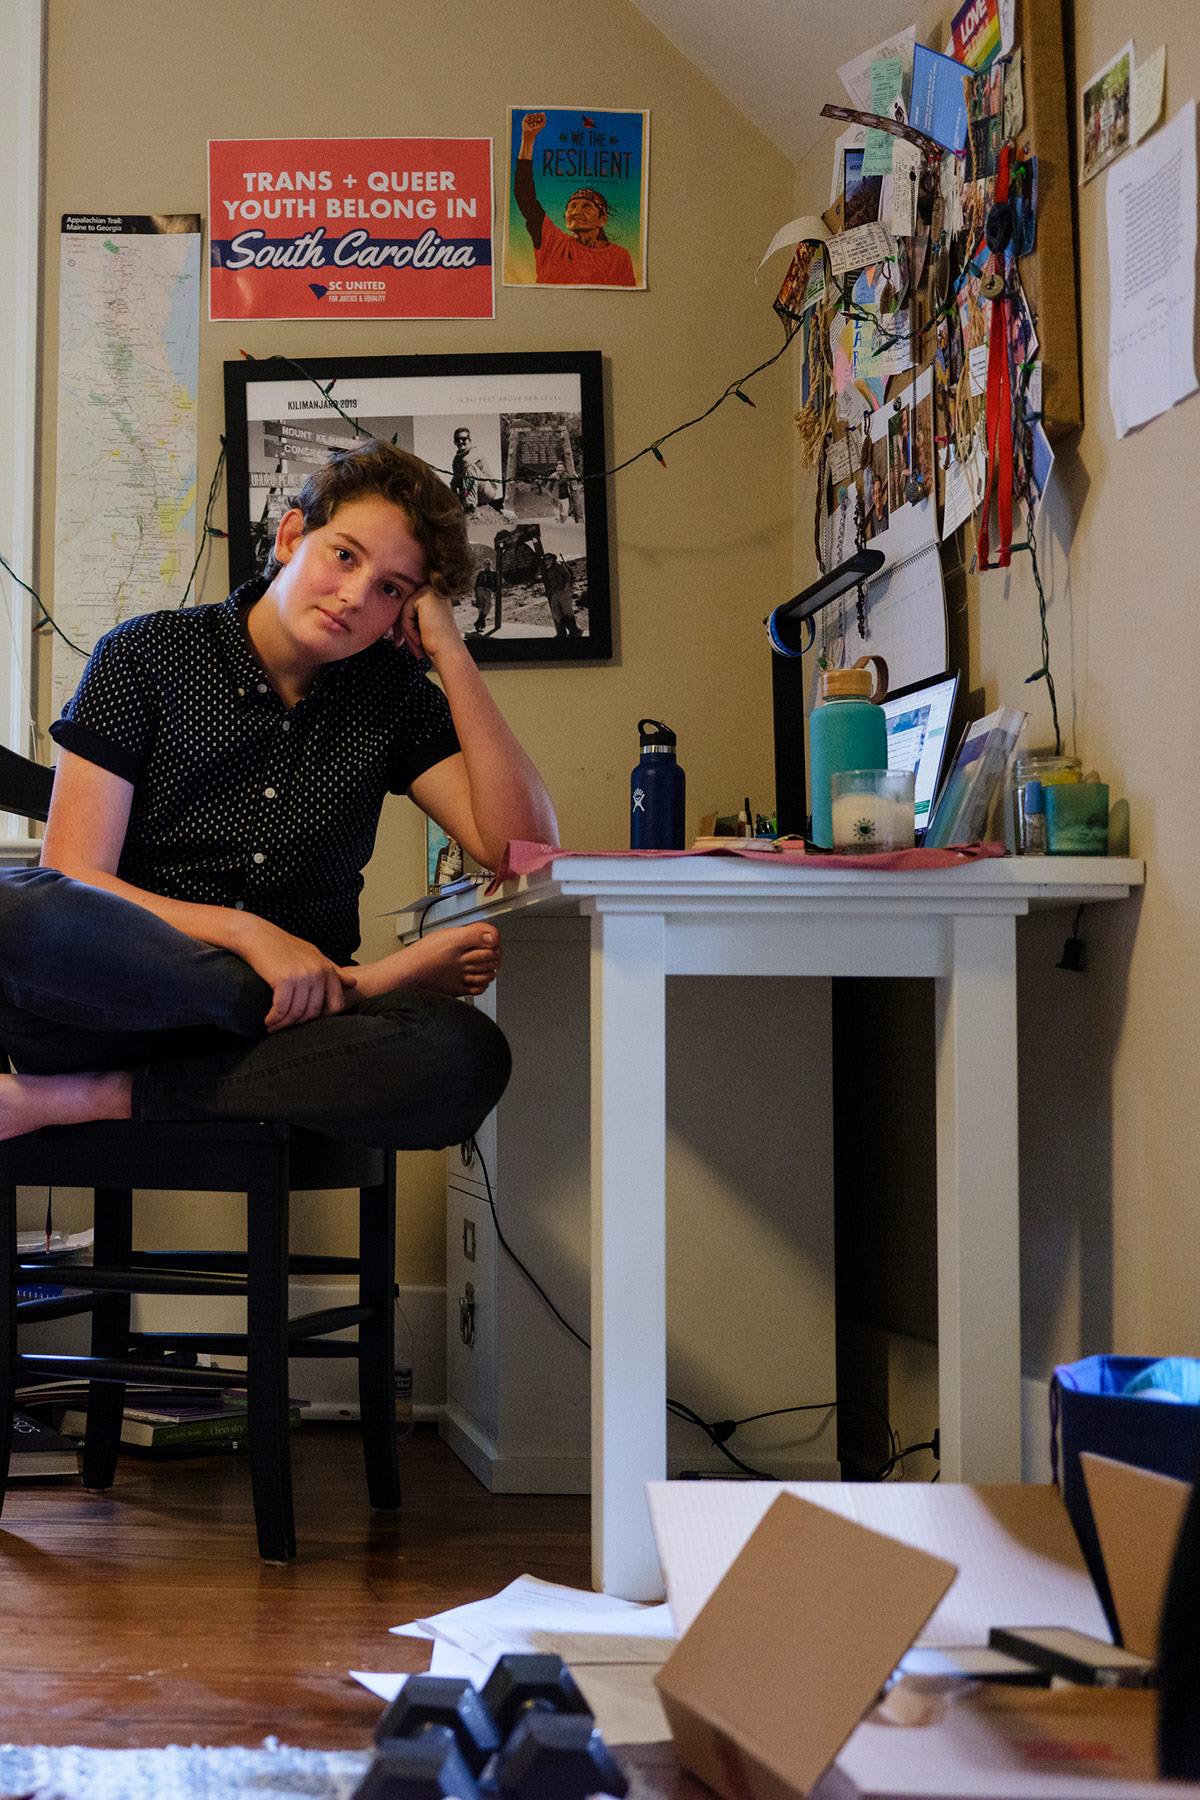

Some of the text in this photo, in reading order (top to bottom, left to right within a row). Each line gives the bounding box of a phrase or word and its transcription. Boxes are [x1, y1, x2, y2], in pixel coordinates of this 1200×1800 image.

[571, 130, 607, 147] WE THE
[542, 149, 633, 179] RESILIENT
[243, 171, 456, 193] TRANS + QUEER
[222, 198, 477, 220] YOUTH BELONG IN
[66, 216, 123, 226] Appalachian Trail:
[96, 225, 122, 233] Georgia
[225, 228, 477, 269] South Carolina
[329, 281, 386, 291] SC UNITED
[340, 399, 358, 409] 2019
[281, 426, 313, 439] MOUNT
[250, 473, 275, 487] UHURU
[209, 1423, 245, 1437] Chemistry
